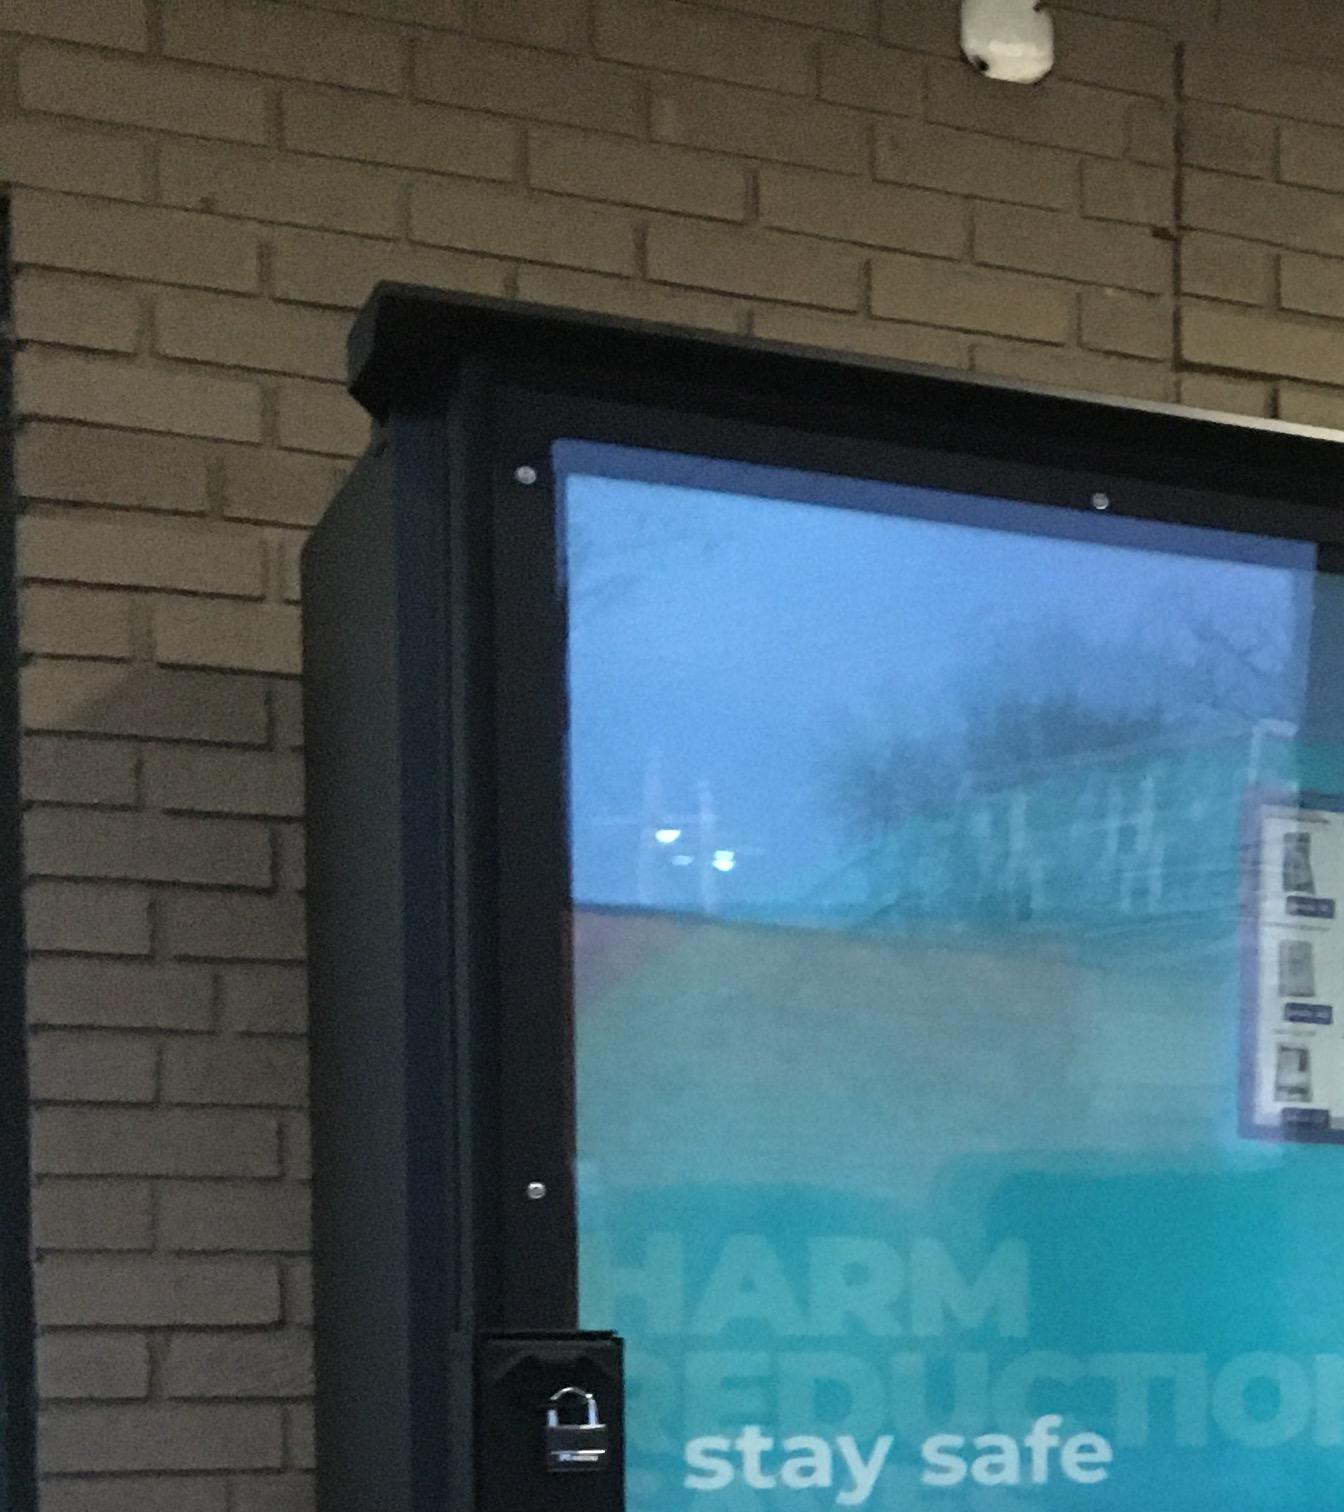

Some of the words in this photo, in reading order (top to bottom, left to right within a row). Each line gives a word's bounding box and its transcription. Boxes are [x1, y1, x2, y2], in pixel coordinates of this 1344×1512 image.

[578, 1230, 1030, 1338] HARM
[683, 1424, 895, 1506] stay
[920, 1414, 1114, 1486] safe
